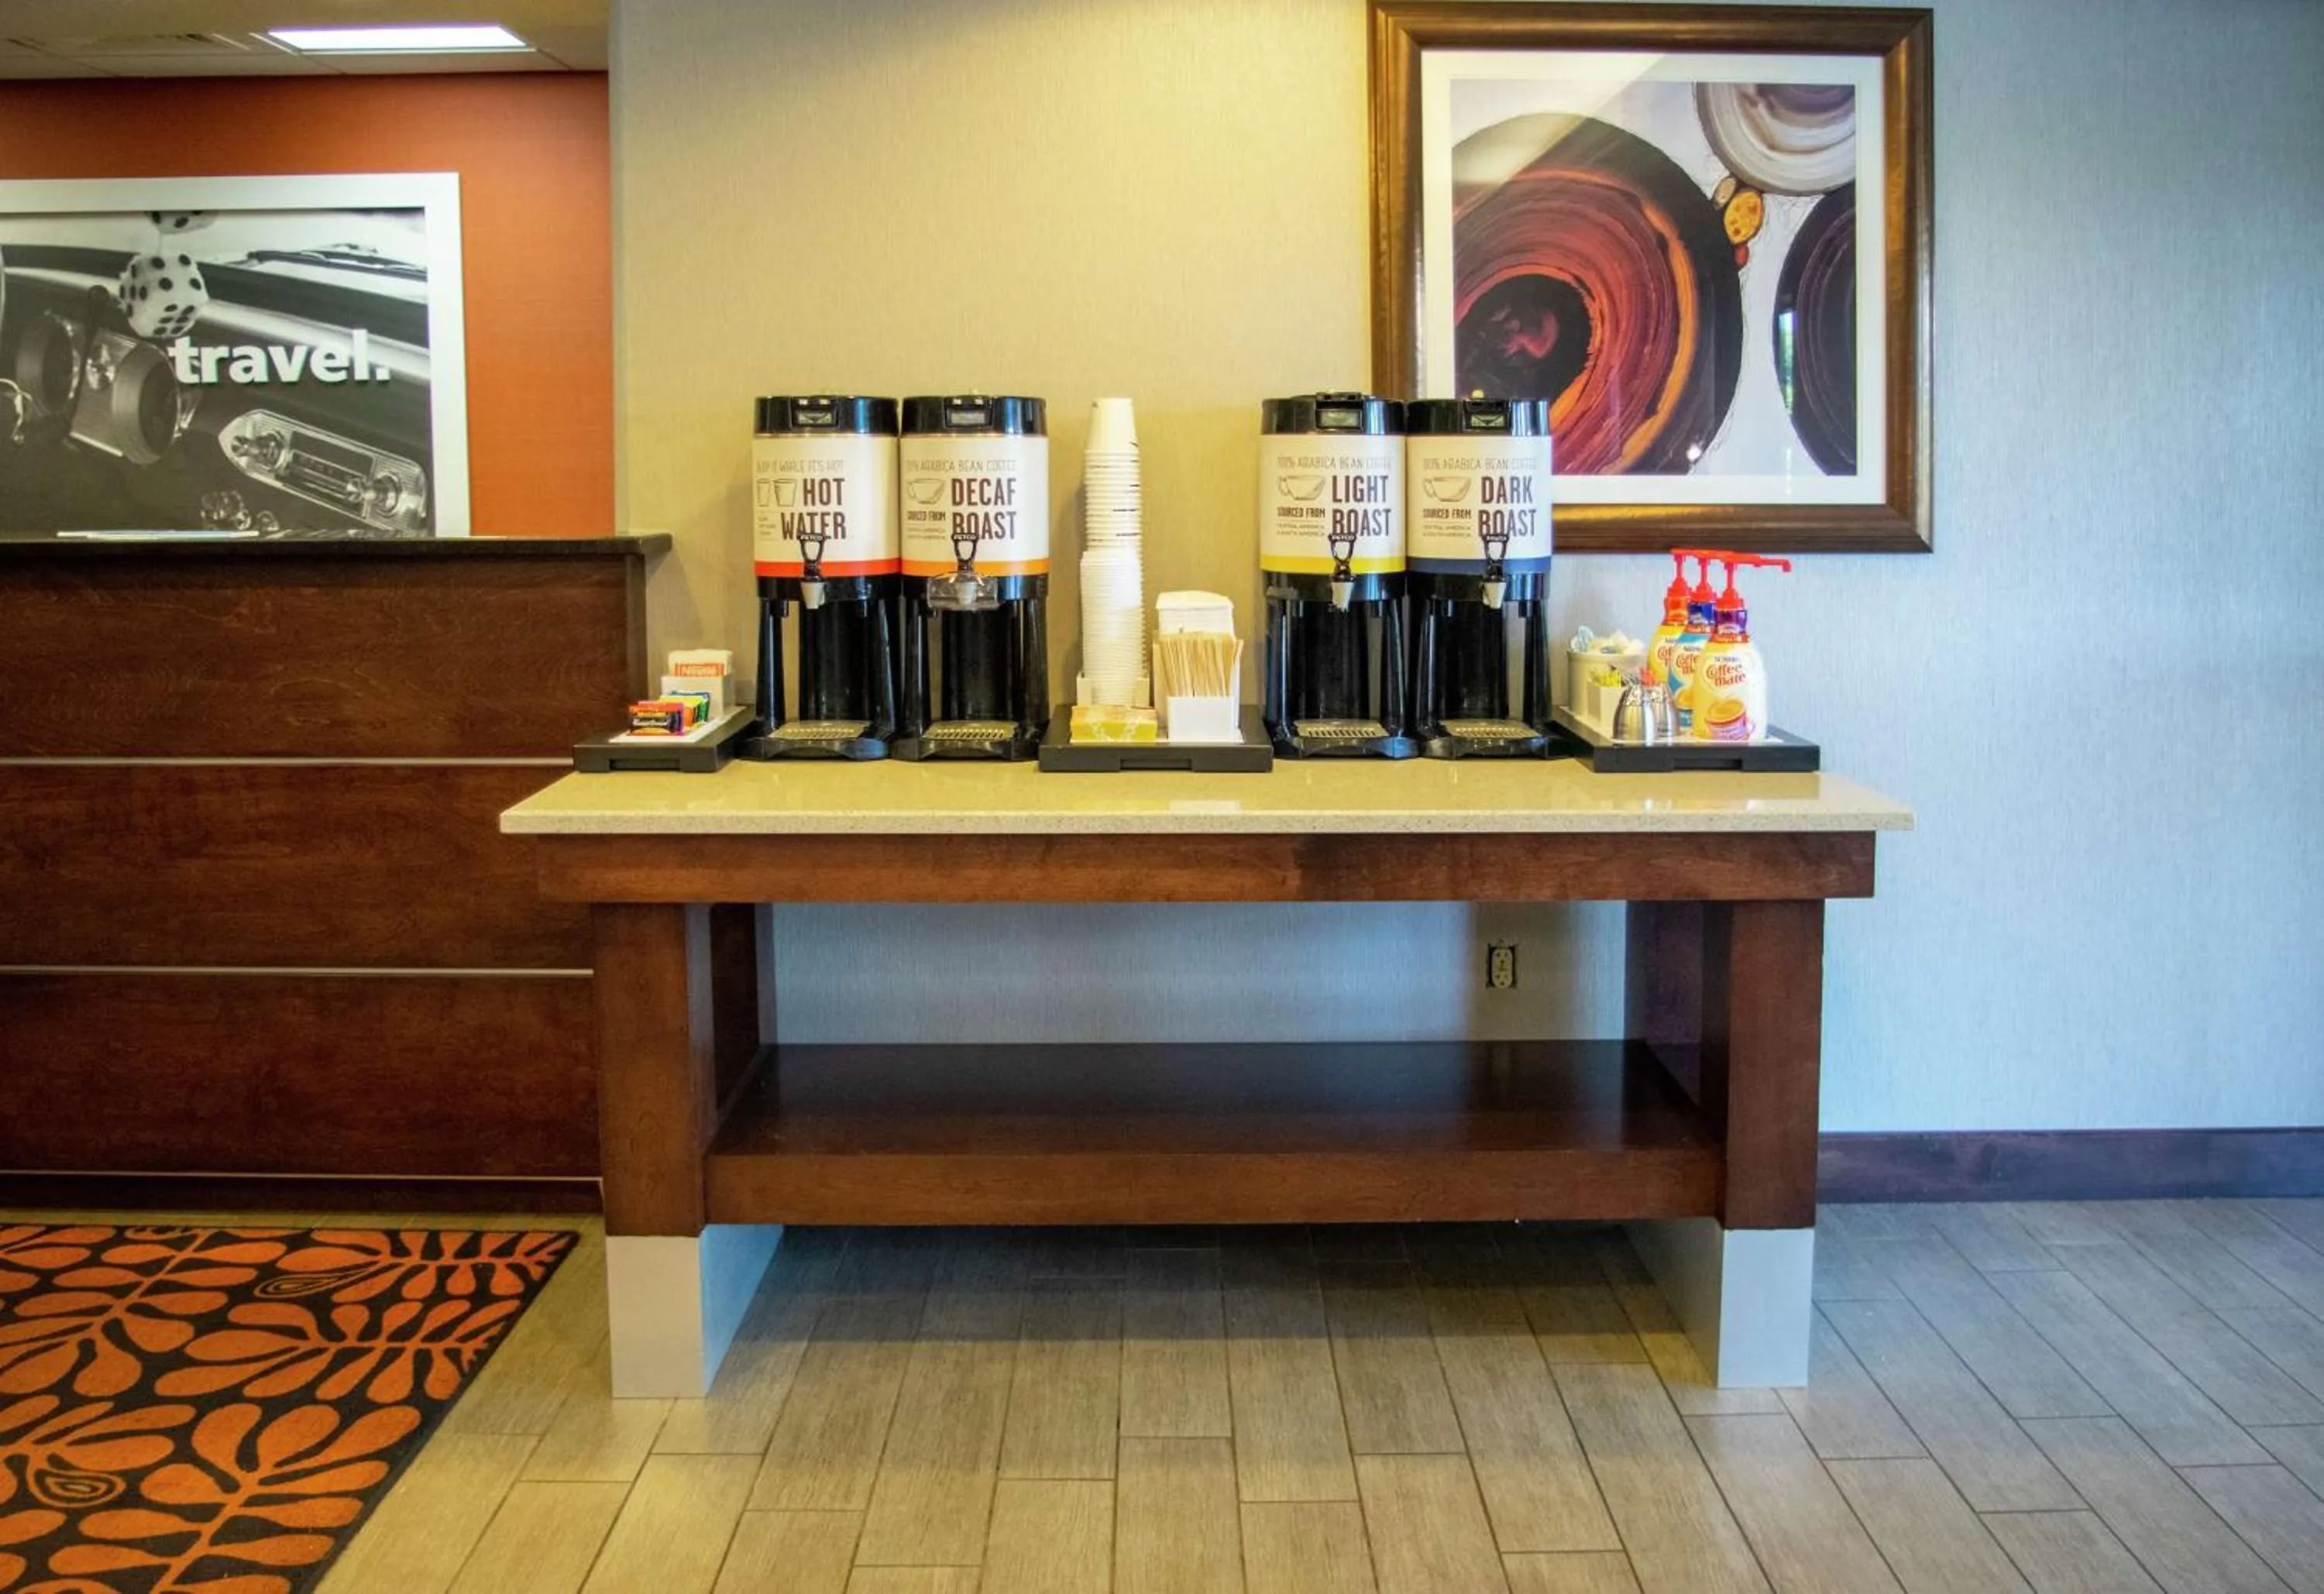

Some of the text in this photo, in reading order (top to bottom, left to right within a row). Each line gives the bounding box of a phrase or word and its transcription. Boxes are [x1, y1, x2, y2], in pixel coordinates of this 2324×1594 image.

[167, 328, 391, 384] travel.
[803, 478, 845, 506] HOT
[951, 477, 1017, 506] DECAF
[1332, 475, 1389, 503] LIGHT
[1480, 476, 1533, 503] DARK
[780, 512, 847, 540] WATER
[951, 511, 1017, 540] ROAST
[1332, 508, 1392, 537] ROAST
[1477, 508, 1537, 538] ROAST
